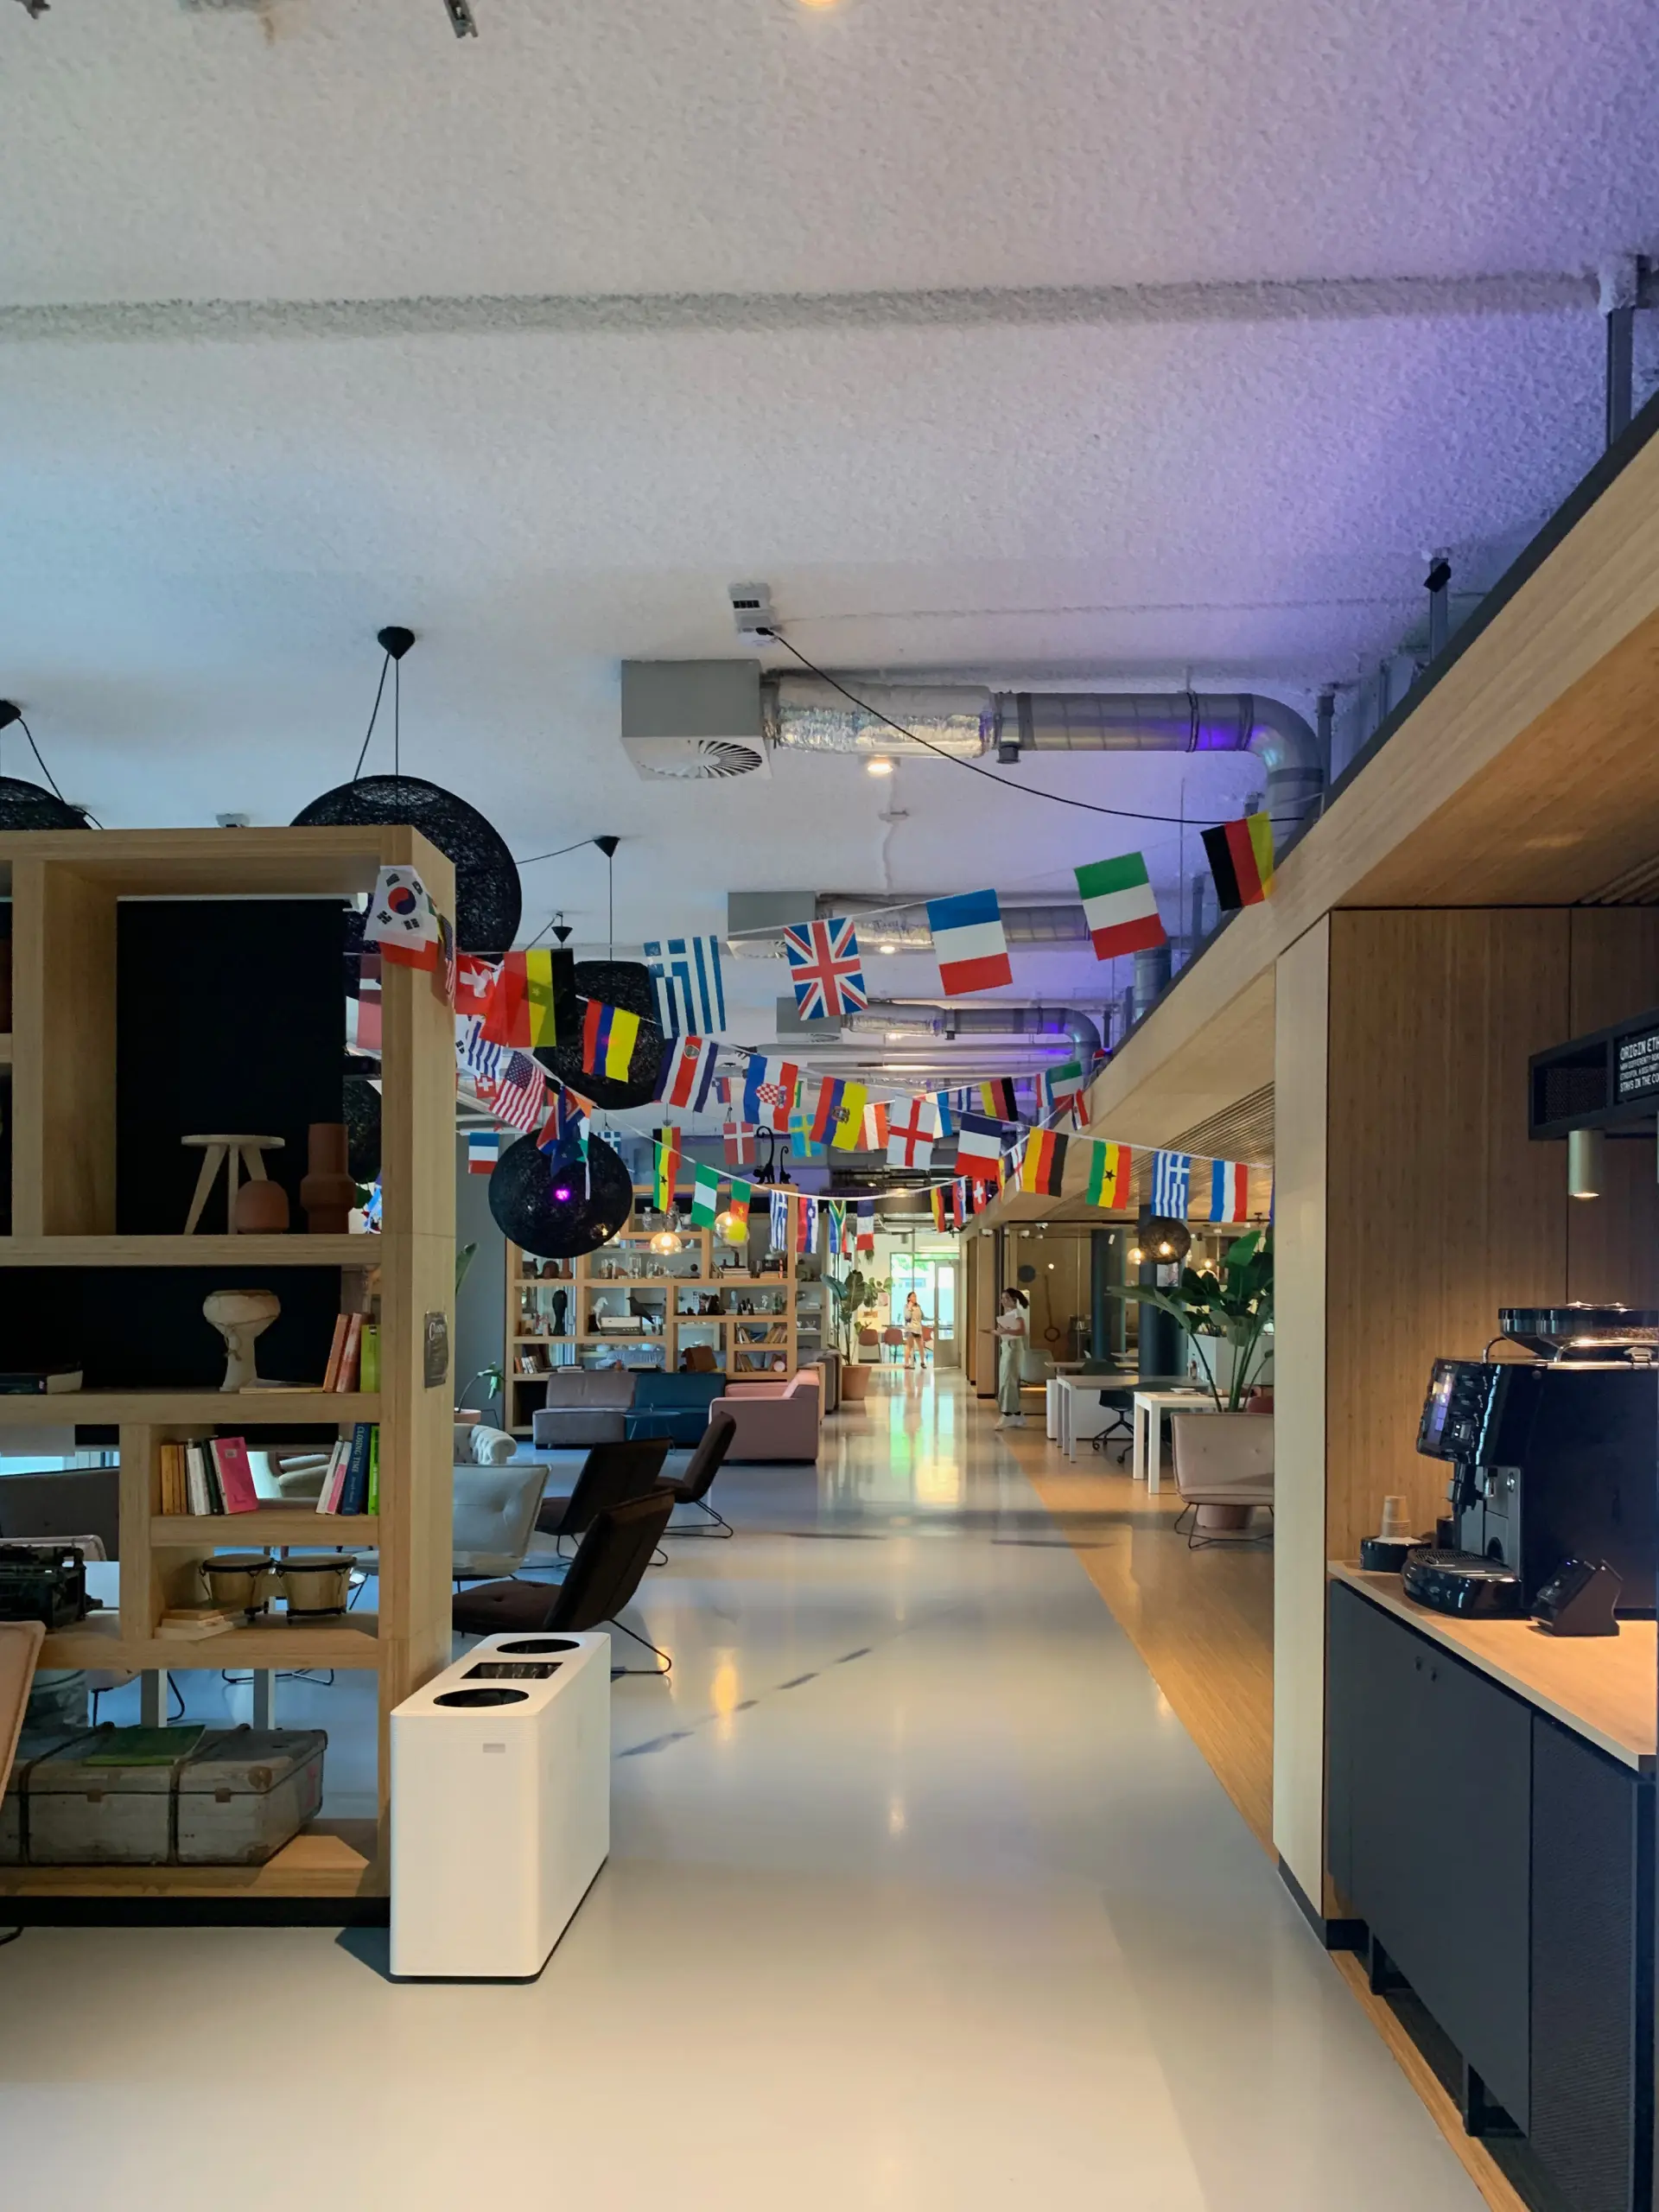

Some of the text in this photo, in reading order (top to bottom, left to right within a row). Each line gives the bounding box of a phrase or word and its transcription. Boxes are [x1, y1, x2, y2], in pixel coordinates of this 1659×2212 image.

[1620, 1040, 1646, 1060] ORIGIN
[1634, 1077, 1641, 1089] IN
[1642, 1074, 1651, 1085] THE
[355, 1426, 365, 1455] CLOSING
[352, 1457, 360, 1472] TIME
